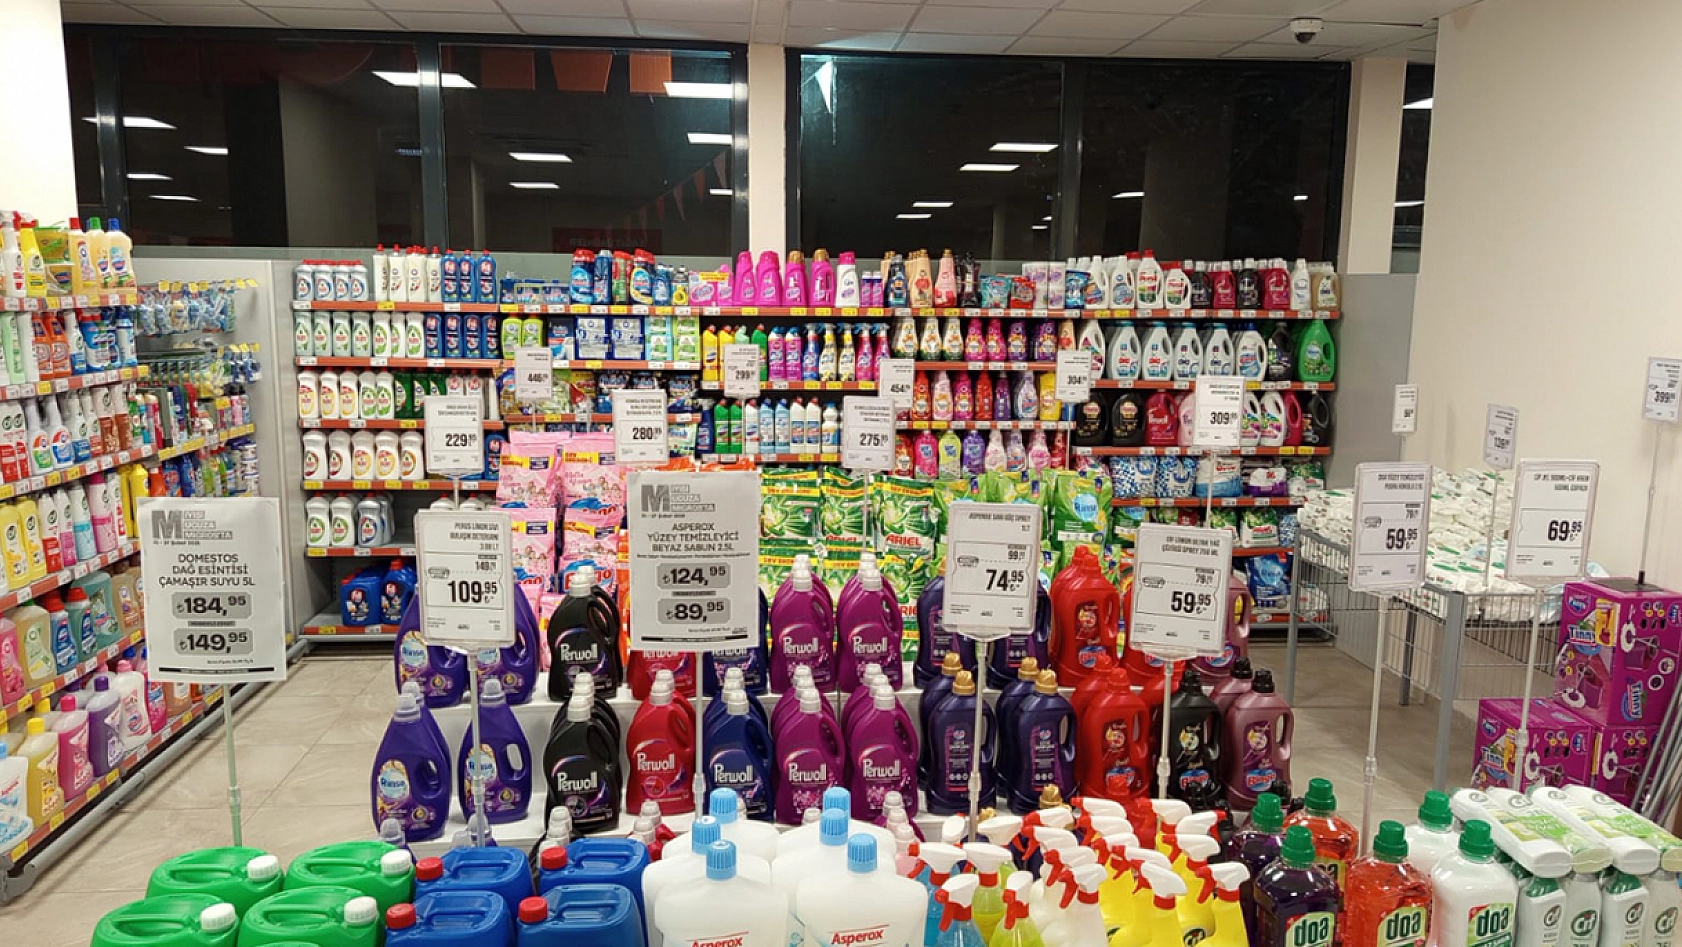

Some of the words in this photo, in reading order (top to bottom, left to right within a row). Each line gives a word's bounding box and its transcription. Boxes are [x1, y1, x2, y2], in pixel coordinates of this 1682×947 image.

[672, 523, 715, 531] ASPEROX
[647, 531, 677, 542] YÜZEY
[680, 531, 739, 542] TEMİZLEYİCİ
[885, 533, 921, 548] ARIEL
[652, 544, 681, 552] BEYAZ
[684, 544, 715, 552] SABUN
[178, 554, 239, 563] DOMESTOS
[172, 563, 195, 575] DAĞ
[198, 563, 249, 575] ESİNTİSİ
[158, 577, 207, 588] ÇAMAŞIR
[210, 577, 240, 586] SUYU
[242, 577, 256, 586] 5L
[560, 643, 598, 661] Perwoll
[782, 636, 819, 654] Perwoll
[853, 636, 888, 654] Perwoll
[637, 752, 675, 771] Perwoll
[862, 758, 900, 778] Perwoll
[713, 763, 753, 784] Perwoll
[788, 762, 827, 783] Perwoll
[557, 772, 597, 792] Perwoll
[1386, 910, 1422, 940] doa
[1476, 905, 1509, 936] doa
[830, 927, 885, 945] Asperox
[1293, 917, 1329, 945] doa
